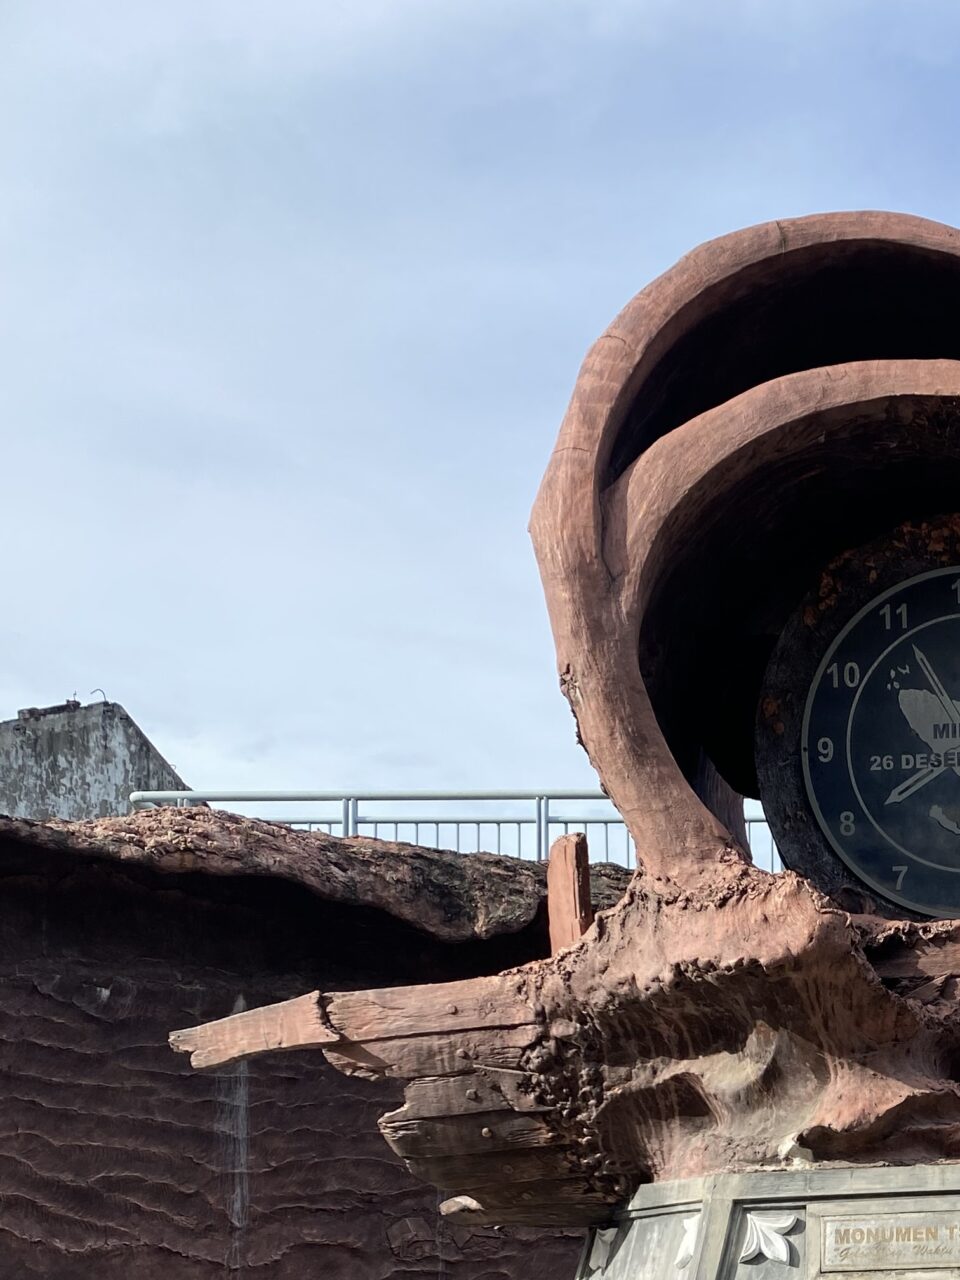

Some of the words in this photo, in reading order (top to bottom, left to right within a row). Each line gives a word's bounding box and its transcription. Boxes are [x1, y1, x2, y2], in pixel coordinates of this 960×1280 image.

[879, 603, 909, 630] 11
[826, 662, 860, 688] 10
[817, 737, 834, 763] 9
[870, 755, 894, 771] 26
[839, 811, 856, 836] 8
[892, 866, 908, 890] 7
[834, 1225, 938, 1245] MONUMEN
